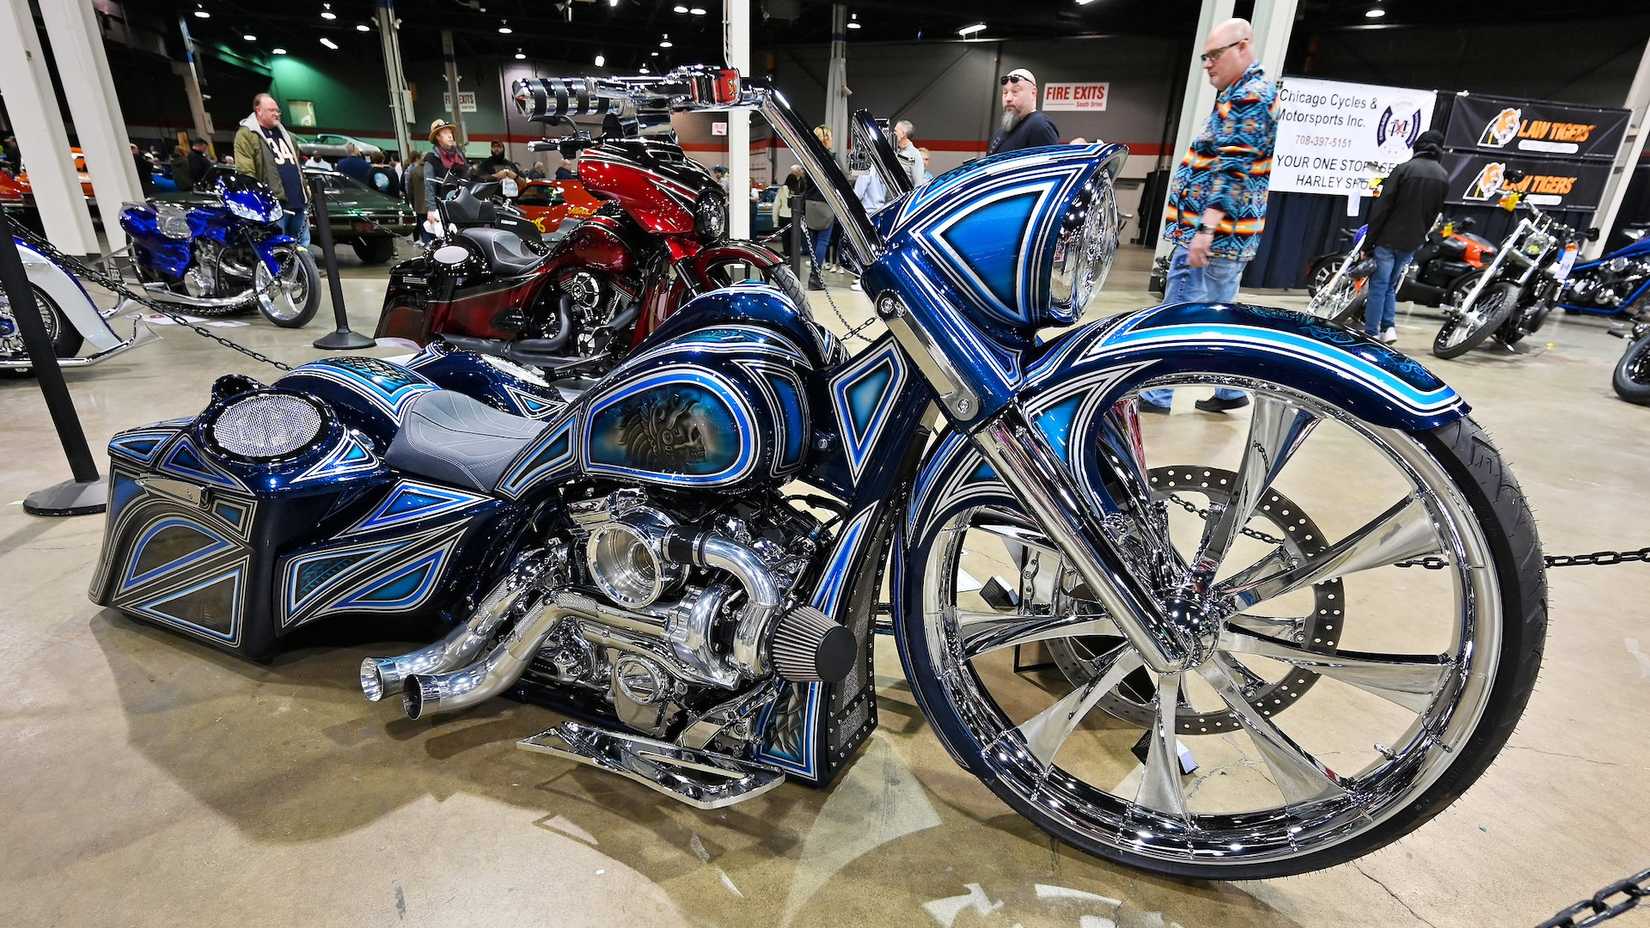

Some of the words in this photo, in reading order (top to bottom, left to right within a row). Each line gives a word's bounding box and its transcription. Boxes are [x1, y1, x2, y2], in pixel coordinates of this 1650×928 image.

[1046, 86, 1071, 100] FIRE
[1073, 86, 1105, 100] EXITS
[1279, 88, 1327, 108] Chicago
[1330, 93, 1367, 110] Cycles
[1369, 96, 1378, 110] &
[1279, 108, 1344, 127] Motorsports
[1346, 114, 1367, 128] Inc.
[1517, 119, 1552, 139] LAW
[1549, 121, 1598, 143] TIGERS
[264, 137, 296, 165] 34
[1295, 134, 1353, 149] 708-397-5151
[1276, 154, 1310, 169] YOUR
[1312, 156, 1339, 171] ONE
[1295, 174, 1344, 189] HARLEY
[1531, 175, 1578, 195] TIGERS
